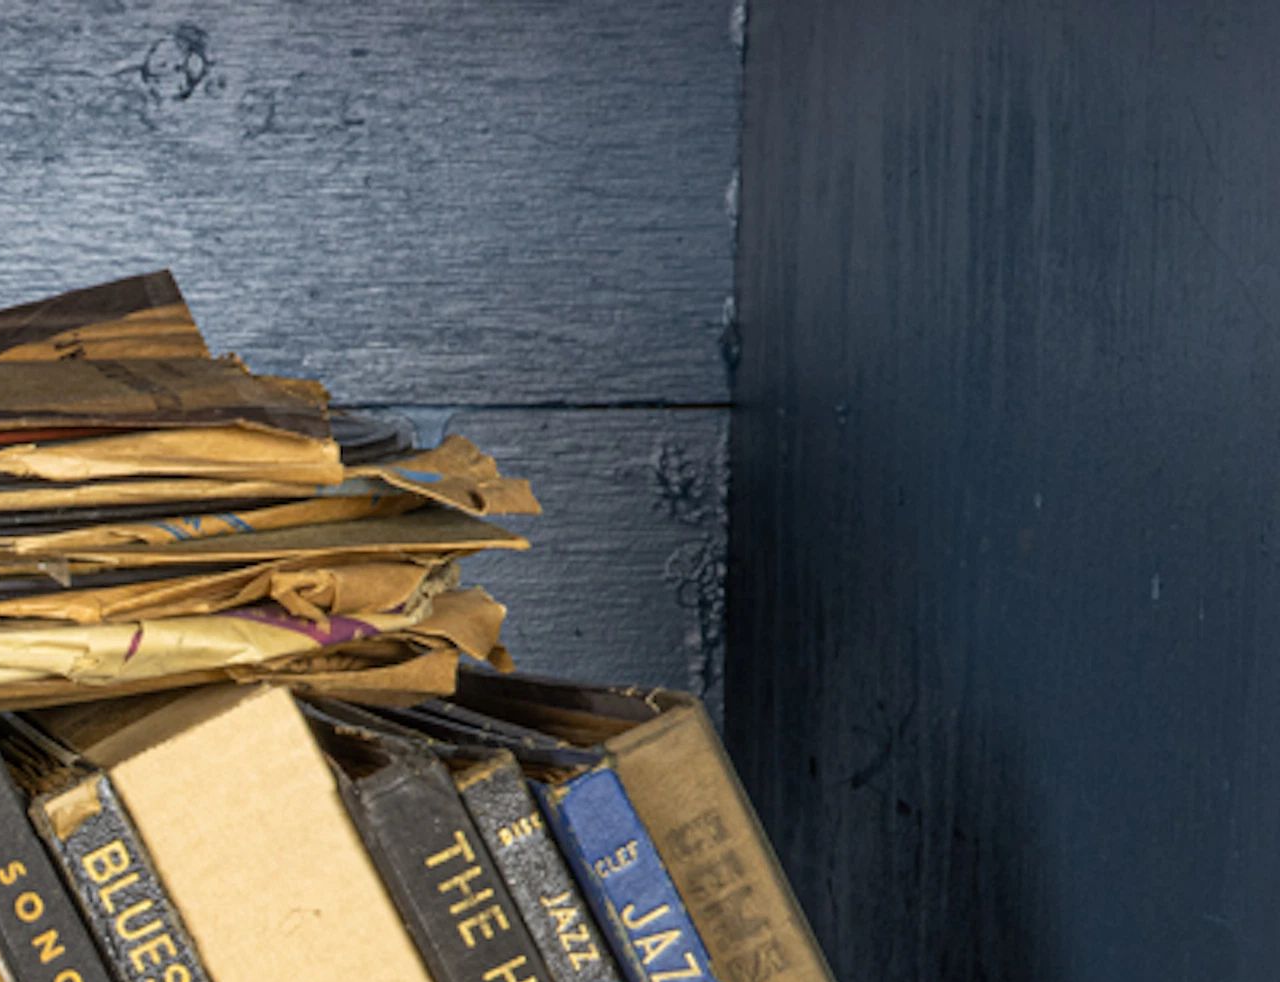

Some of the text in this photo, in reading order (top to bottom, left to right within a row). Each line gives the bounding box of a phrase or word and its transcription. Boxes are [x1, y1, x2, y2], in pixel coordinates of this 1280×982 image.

[425, 830, 509, 947] THE
[594, 840, 638, 878] CLEF
[540, 892, 599, 971] JAZZ
